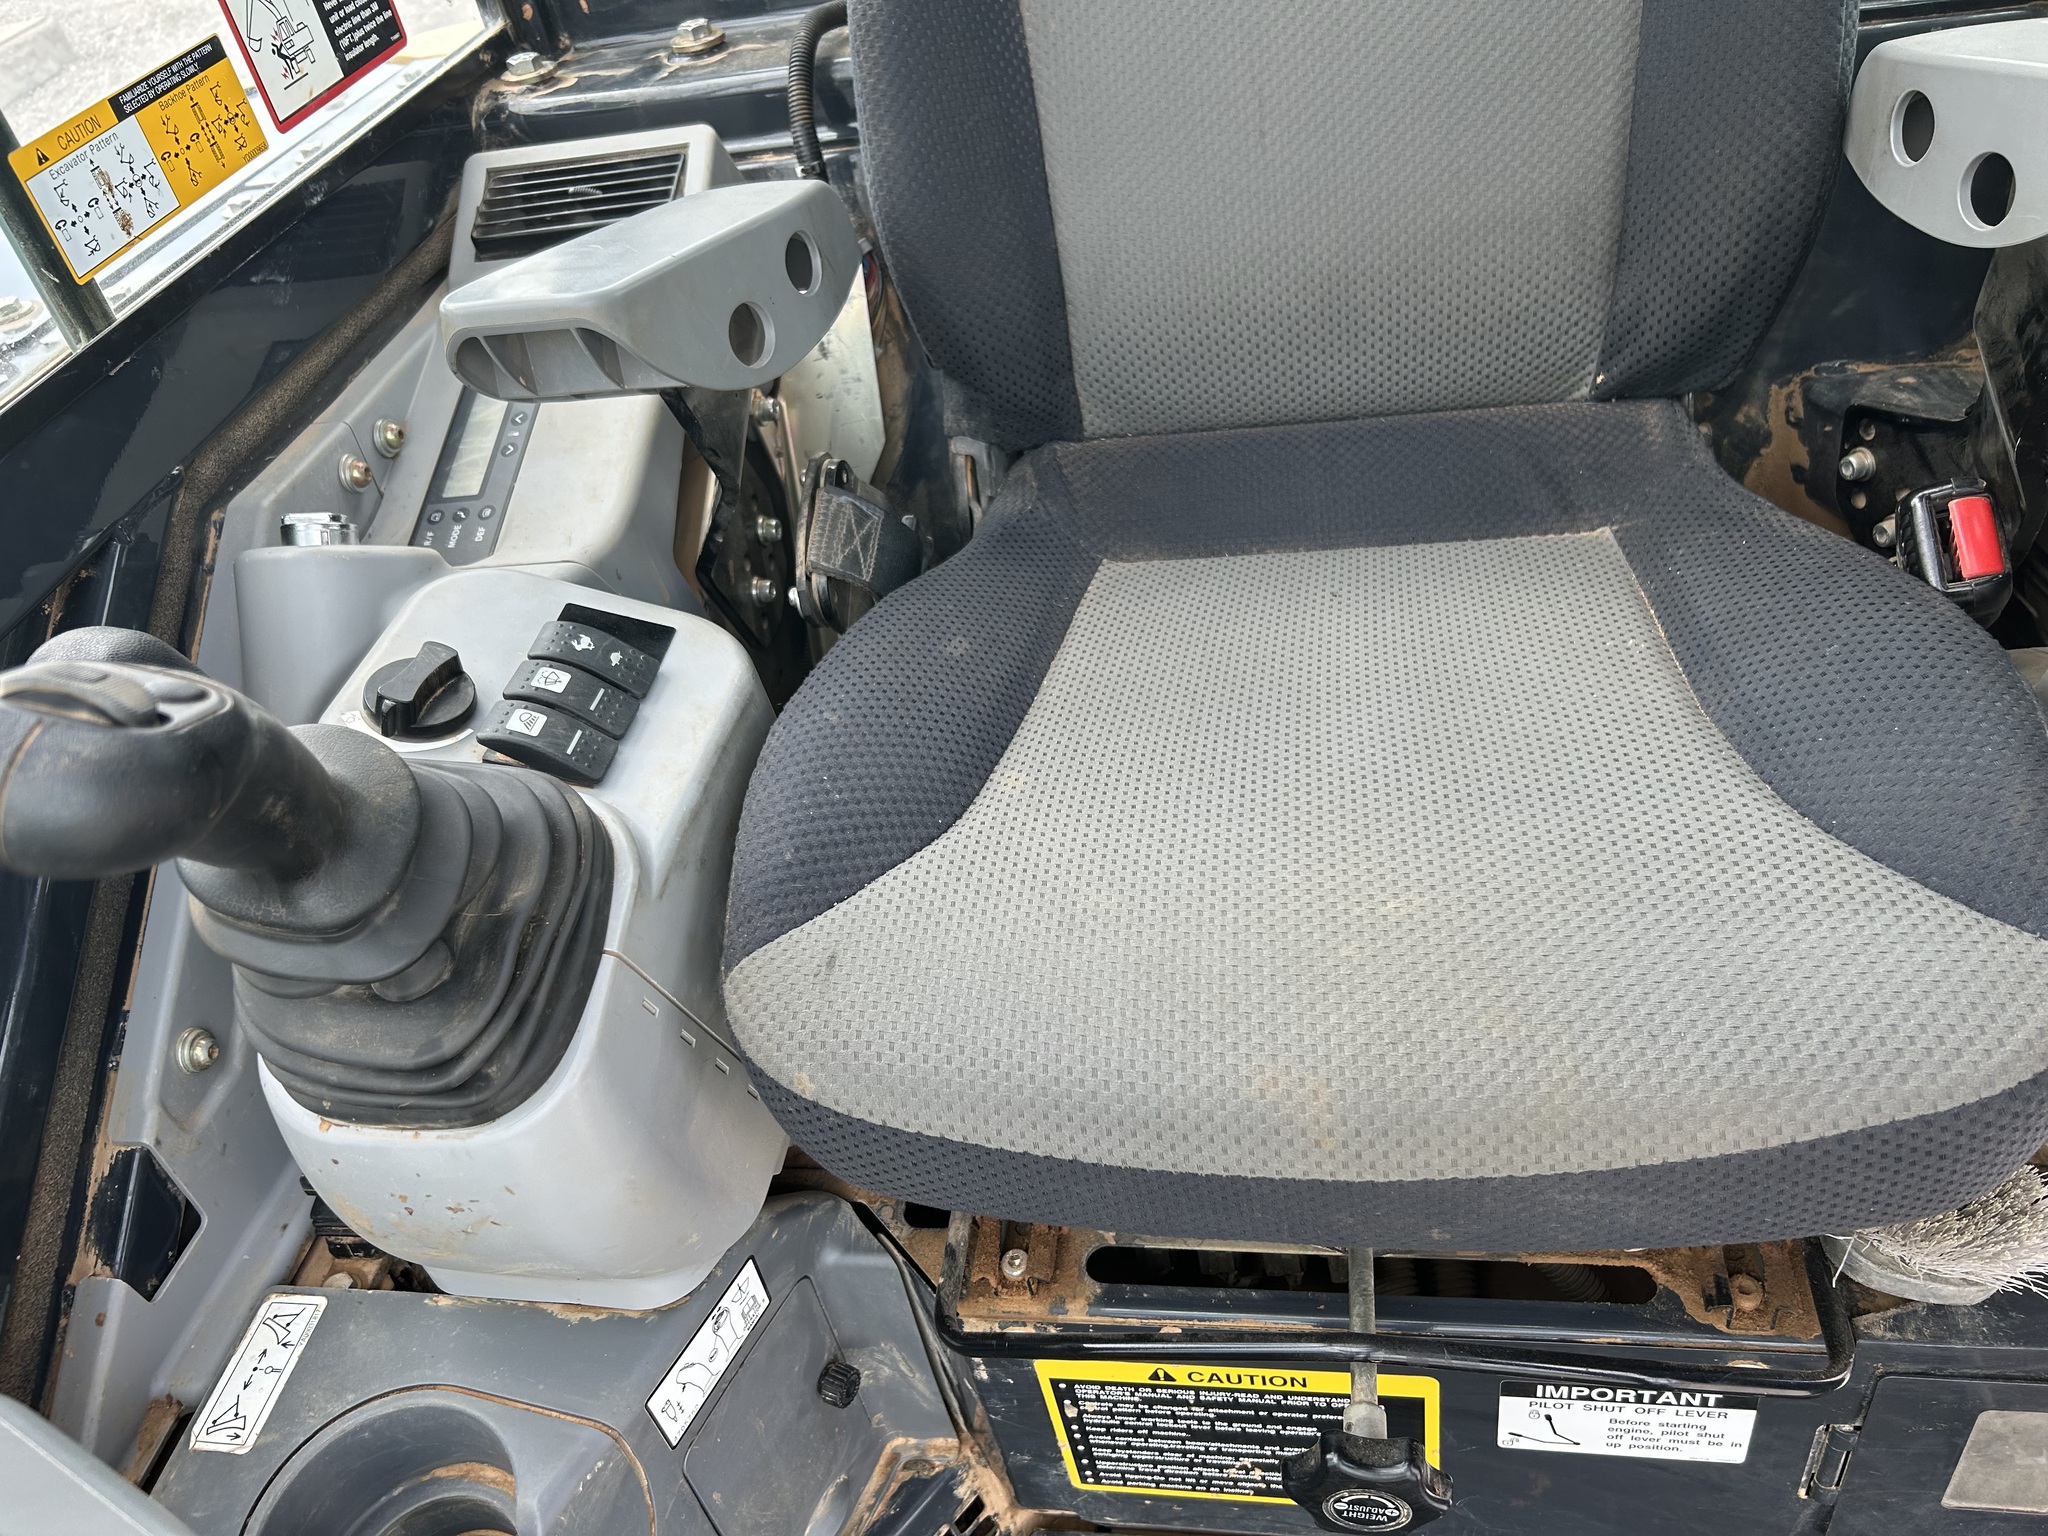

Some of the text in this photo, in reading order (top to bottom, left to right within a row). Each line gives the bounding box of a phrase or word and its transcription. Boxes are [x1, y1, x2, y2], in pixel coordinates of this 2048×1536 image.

[329, 12, 339, 23] unit
[339, 9, 345, 17] or
[344, 1, 355, 14] load
[334, 2, 379, 36] electric line than 3M
[363, 20, 376, 32] twice
[375, 15, 384, 24] the
[382, 10, 392, 19] line
[344, 44, 365, 61] insulator
[363, 33, 379, 48] length.
[119, 43, 212, 104] FAMILIARIZE YOURSELF WITH THE PATTERN
[123, 94, 149, 113] SELECTED
[148, 88, 157, 101] BY
[155, 74, 182, 94] OPERATING
[158, 75, 210, 111] Backhoe Pattern
[57, 114, 101, 150] CAUTION
[49, 132, 118, 180] Excavator Pattern
[448, 524, 462, 548] MODE
[475, 526, 485, 541] DEF
[1186, 1370, 1307, 1388] CAUTION
[1288, 1395, 1350, 1403] UNDERSTAND
[1536, 1384, 1723, 1407] IMPORTANT
[1529, 1401, 1728, 1419] PILOT SHUT OFF LEVER
[1608, 1426, 1725, 1439] engine, pilot shut
[1610, 1418, 1707, 1431] Before starting
[1606, 1441, 1683, 1453] up position.
[1607, 1434, 1742, 1449] off lever must be in
[1341, 1510, 1388, 1522] WEIGHT
[1348, 1504, 1385, 1513] ADJUST
